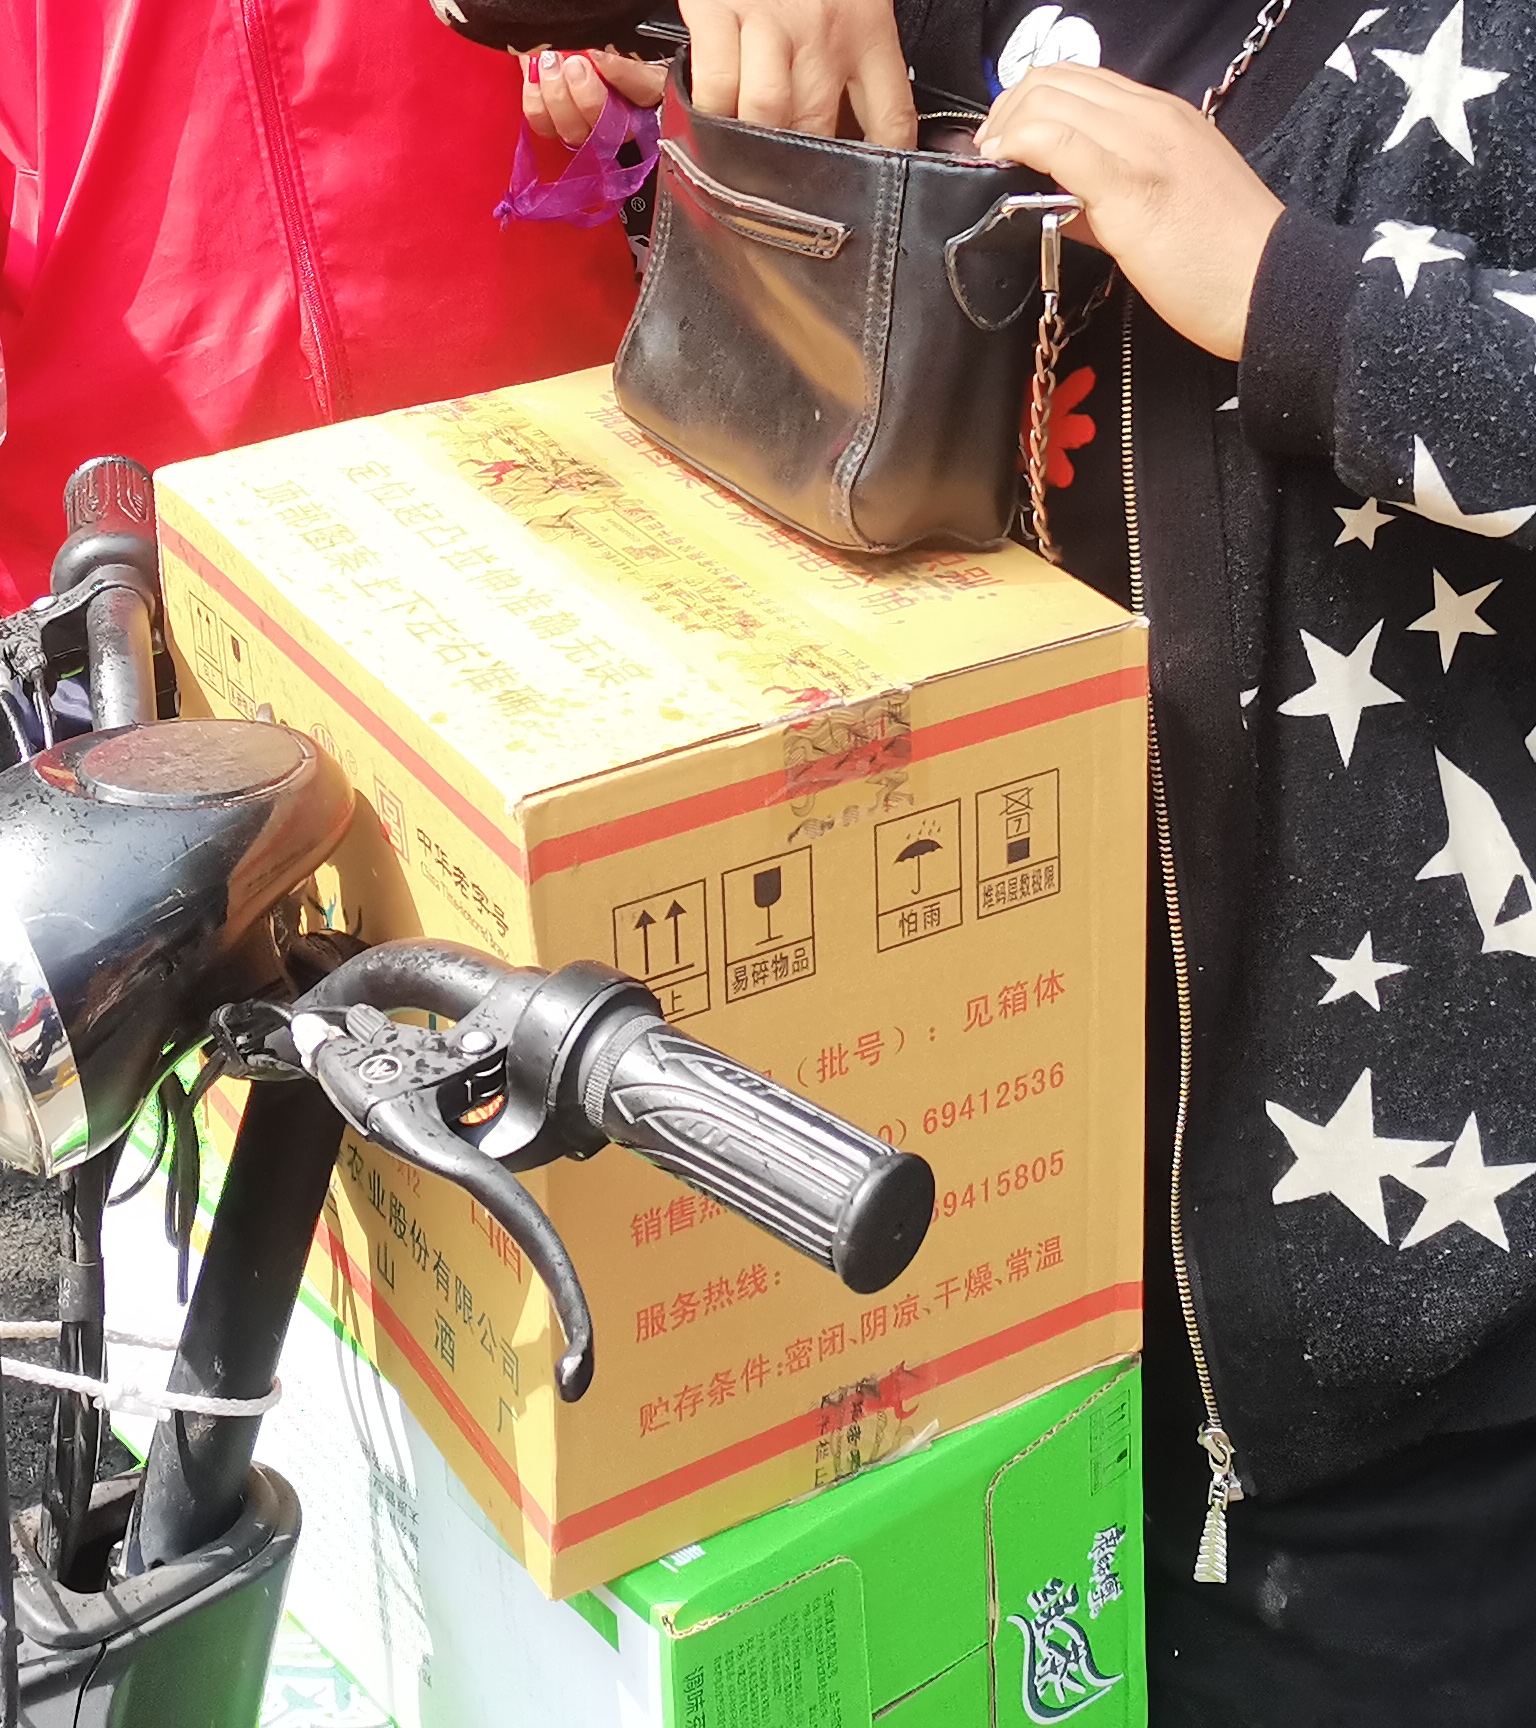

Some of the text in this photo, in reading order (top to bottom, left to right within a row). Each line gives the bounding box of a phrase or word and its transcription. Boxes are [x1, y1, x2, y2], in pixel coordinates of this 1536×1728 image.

[417, 827, 510, 938] 中华老字号
[982, 865, 1057, 910] 堆码层数极限
[898, 901, 942, 938] 怕雨
[731, 946, 810, 993] 易碎物品
[338, 1142, 521, 1397] 农业股份有限公司
